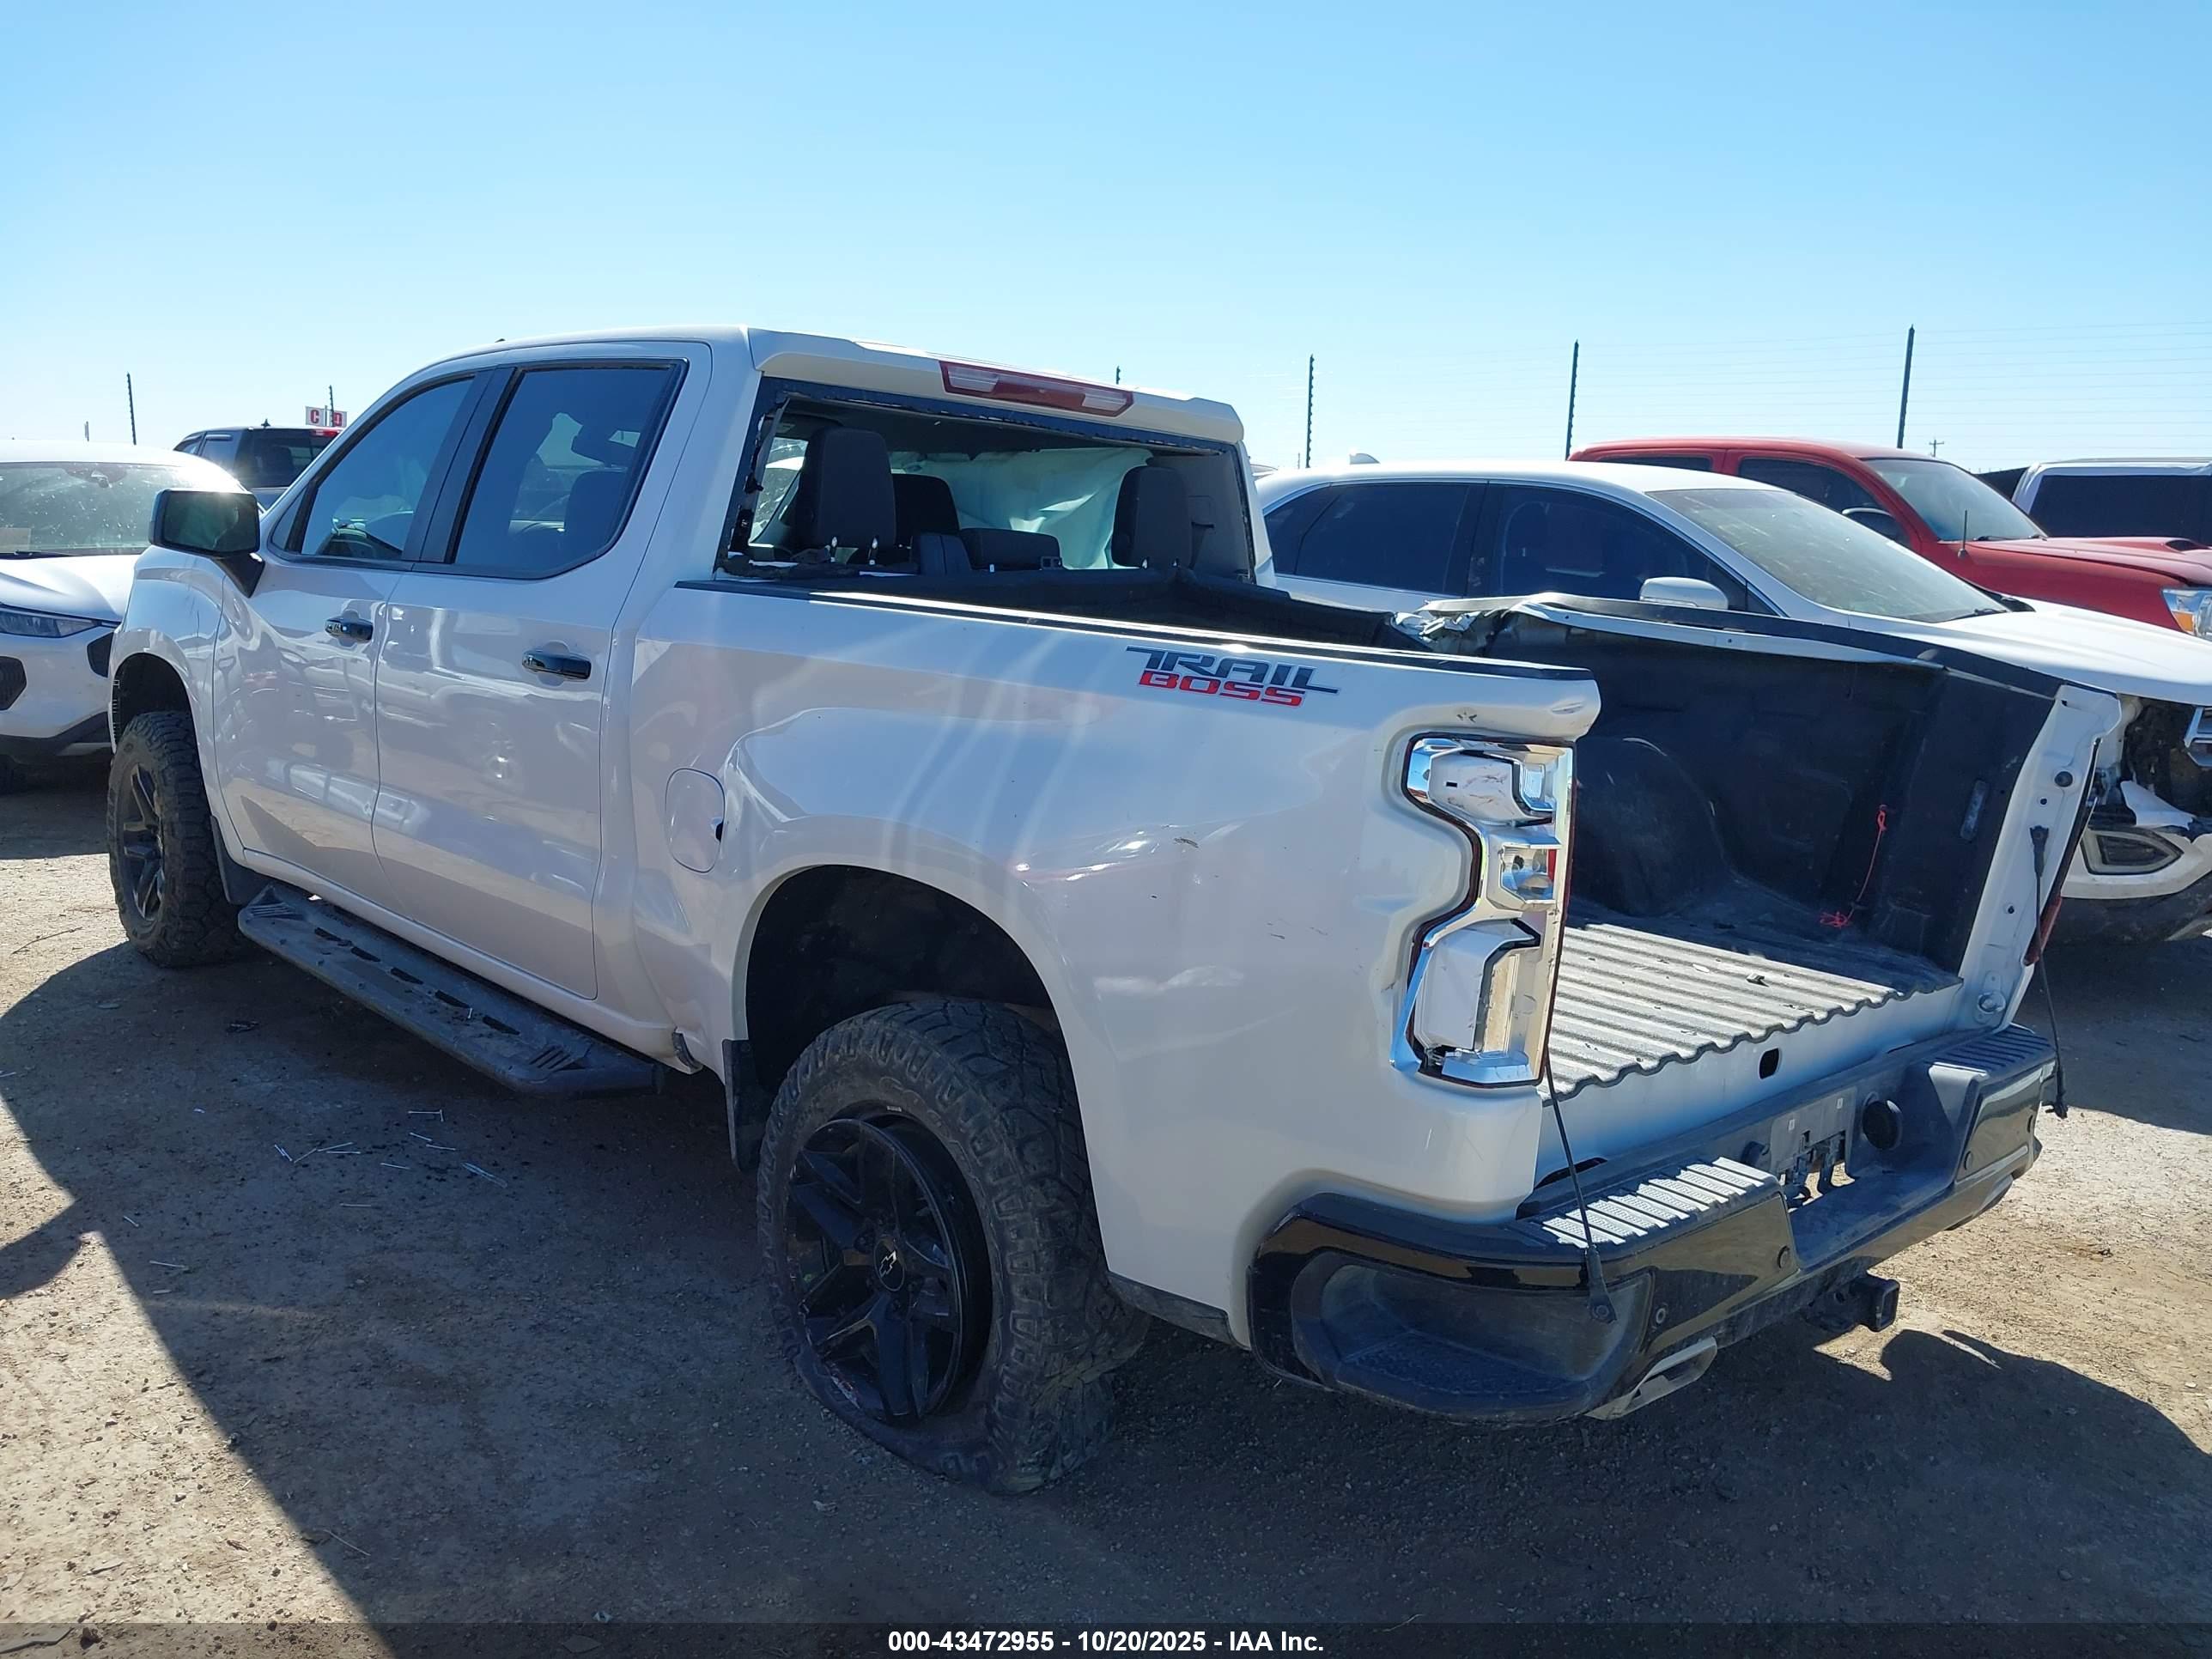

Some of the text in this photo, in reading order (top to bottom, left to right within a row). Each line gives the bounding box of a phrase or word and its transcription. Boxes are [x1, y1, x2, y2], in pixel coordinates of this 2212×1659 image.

[310, 409, 319, 423] C
[1126, 646, 1339, 694] TRAIL
[1139, 670, 1306, 707] BOSS
